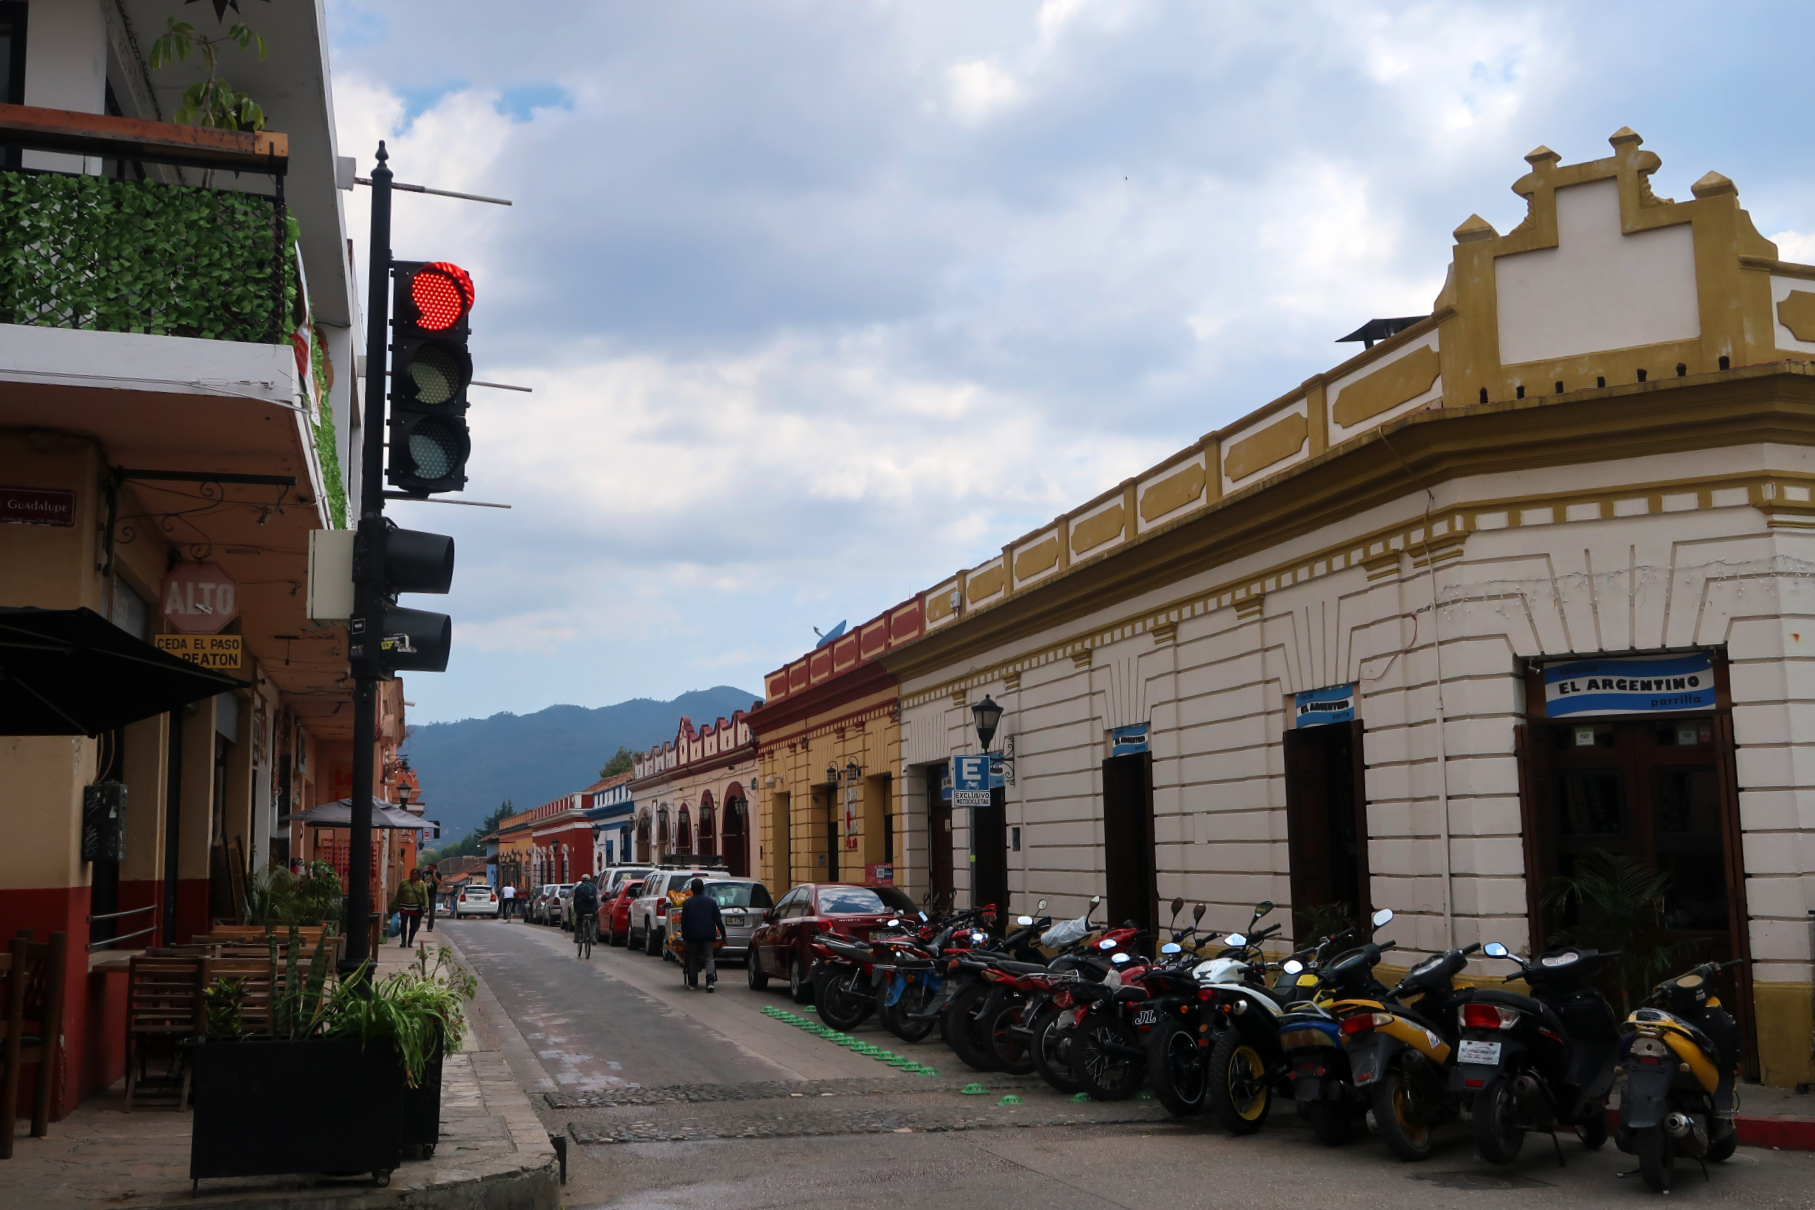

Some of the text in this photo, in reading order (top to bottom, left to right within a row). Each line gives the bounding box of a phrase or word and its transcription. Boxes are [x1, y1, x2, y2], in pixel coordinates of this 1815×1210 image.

[164, 581, 234, 616] ALTO
[157, 638, 240, 650] CEDA EL PASO
[1559, 664, 1598, 675] cocina
[1559, 675, 1700, 695] EL ARGENTINO
[1650, 694, 1702, 708] parrilla
[962, 758, 982, 780] E
[1134, 1009, 1157, 1025] JL
